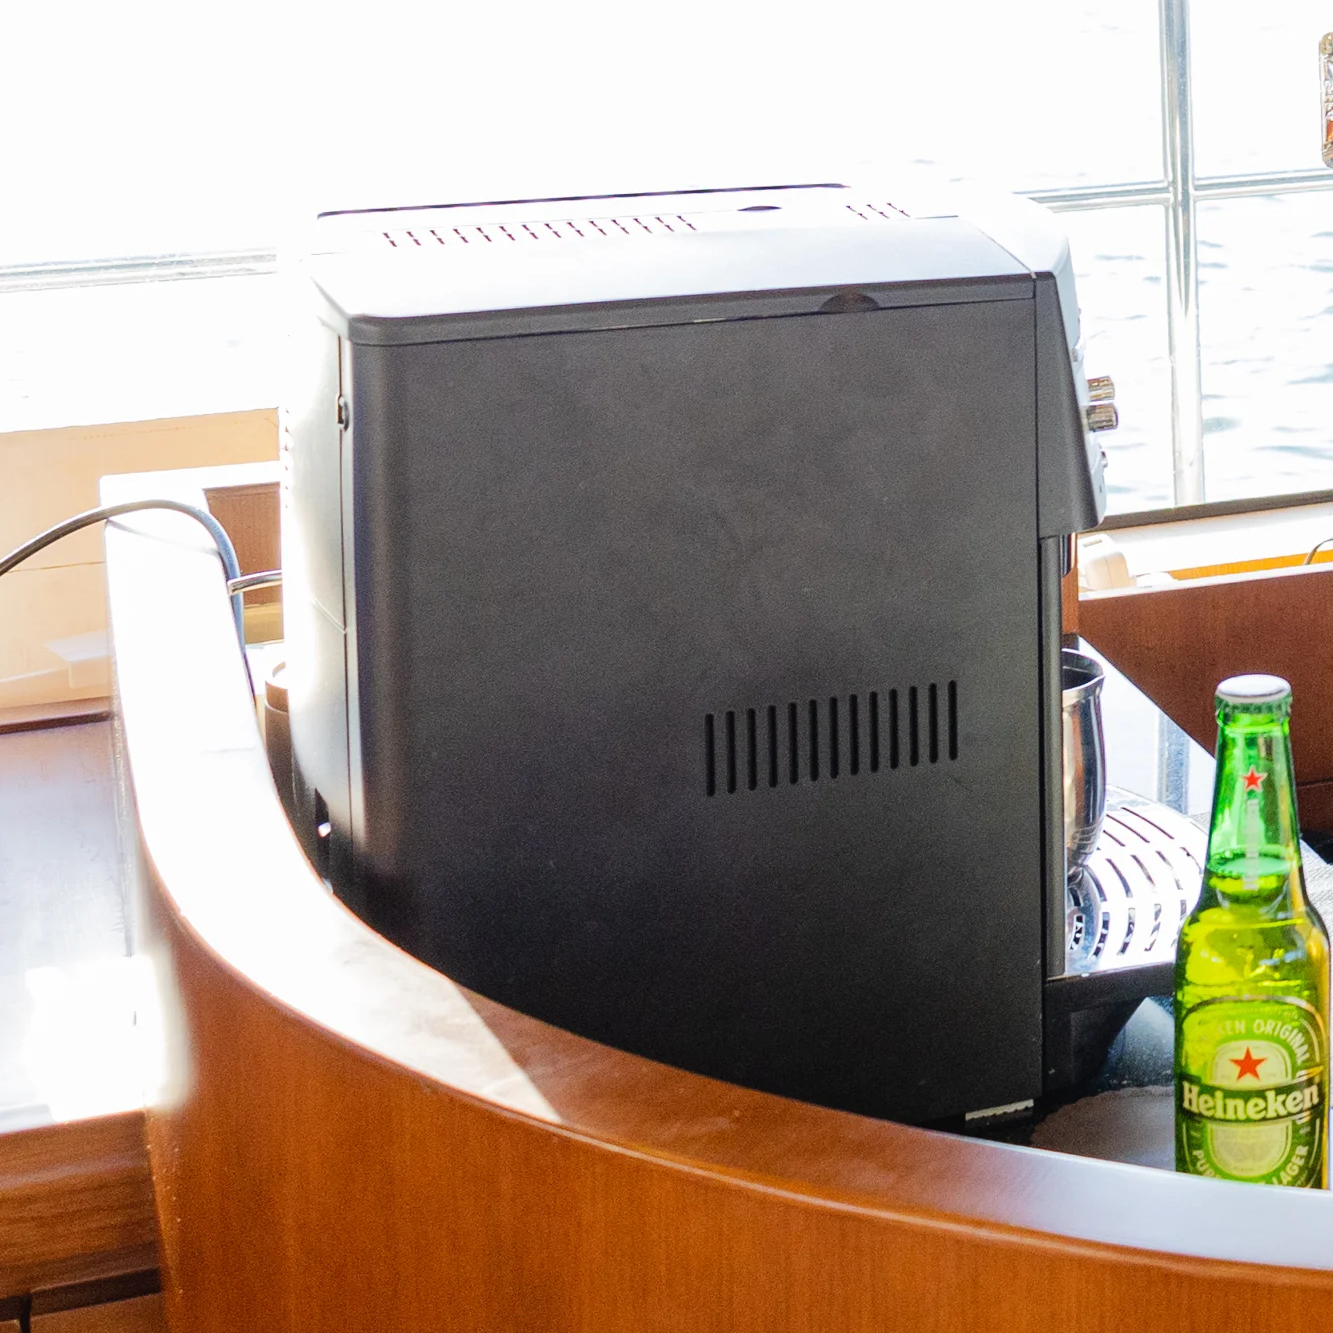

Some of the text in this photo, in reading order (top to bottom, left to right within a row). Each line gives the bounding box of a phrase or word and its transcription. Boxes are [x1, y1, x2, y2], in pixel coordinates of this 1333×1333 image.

[1253, 1018, 1311, 1066] ORIGINAL
[1182, 1080, 1320, 1121] Heineken
[1272, 1144, 1309, 1186] LAGER
